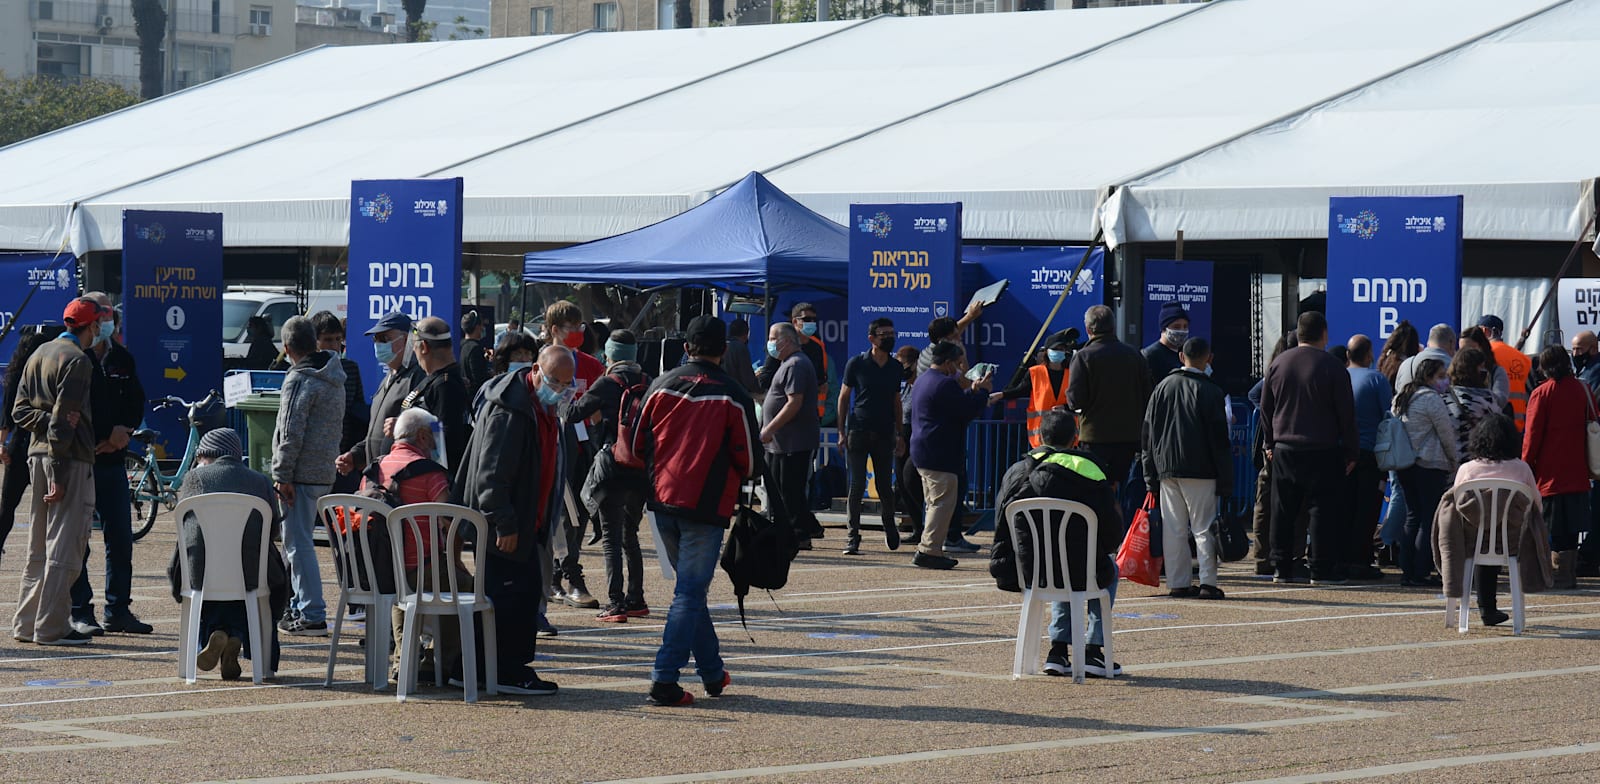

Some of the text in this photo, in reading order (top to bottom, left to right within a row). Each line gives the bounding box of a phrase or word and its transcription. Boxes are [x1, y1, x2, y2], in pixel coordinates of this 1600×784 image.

[414, 199, 436, 209] איכילוב
[913, 217, 936, 226] איכילוב
[1405, 216, 1432, 226] איכילוב
[872, 250, 929, 267] הבריאות
[27, 267, 56, 280] איכילוב
[156, 267, 197, 284] מודיעין
[368, 262, 435, 289] ברוכים
[869, 268, 931, 292] מעל הכל
[1031, 266, 1072, 283] איכילוב
[134, 282, 217, 303] ושרות לקוחות
[1177, 284, 1209, 294] האכילה,
[1352, 277, 1428, 303] מתחם
[1575, 288, 1600, 307] קום
[368, 294, 433, 321] הבאים
[1576, 306, 1600, 325] לם
[1379, 306, 1400, 340] B
